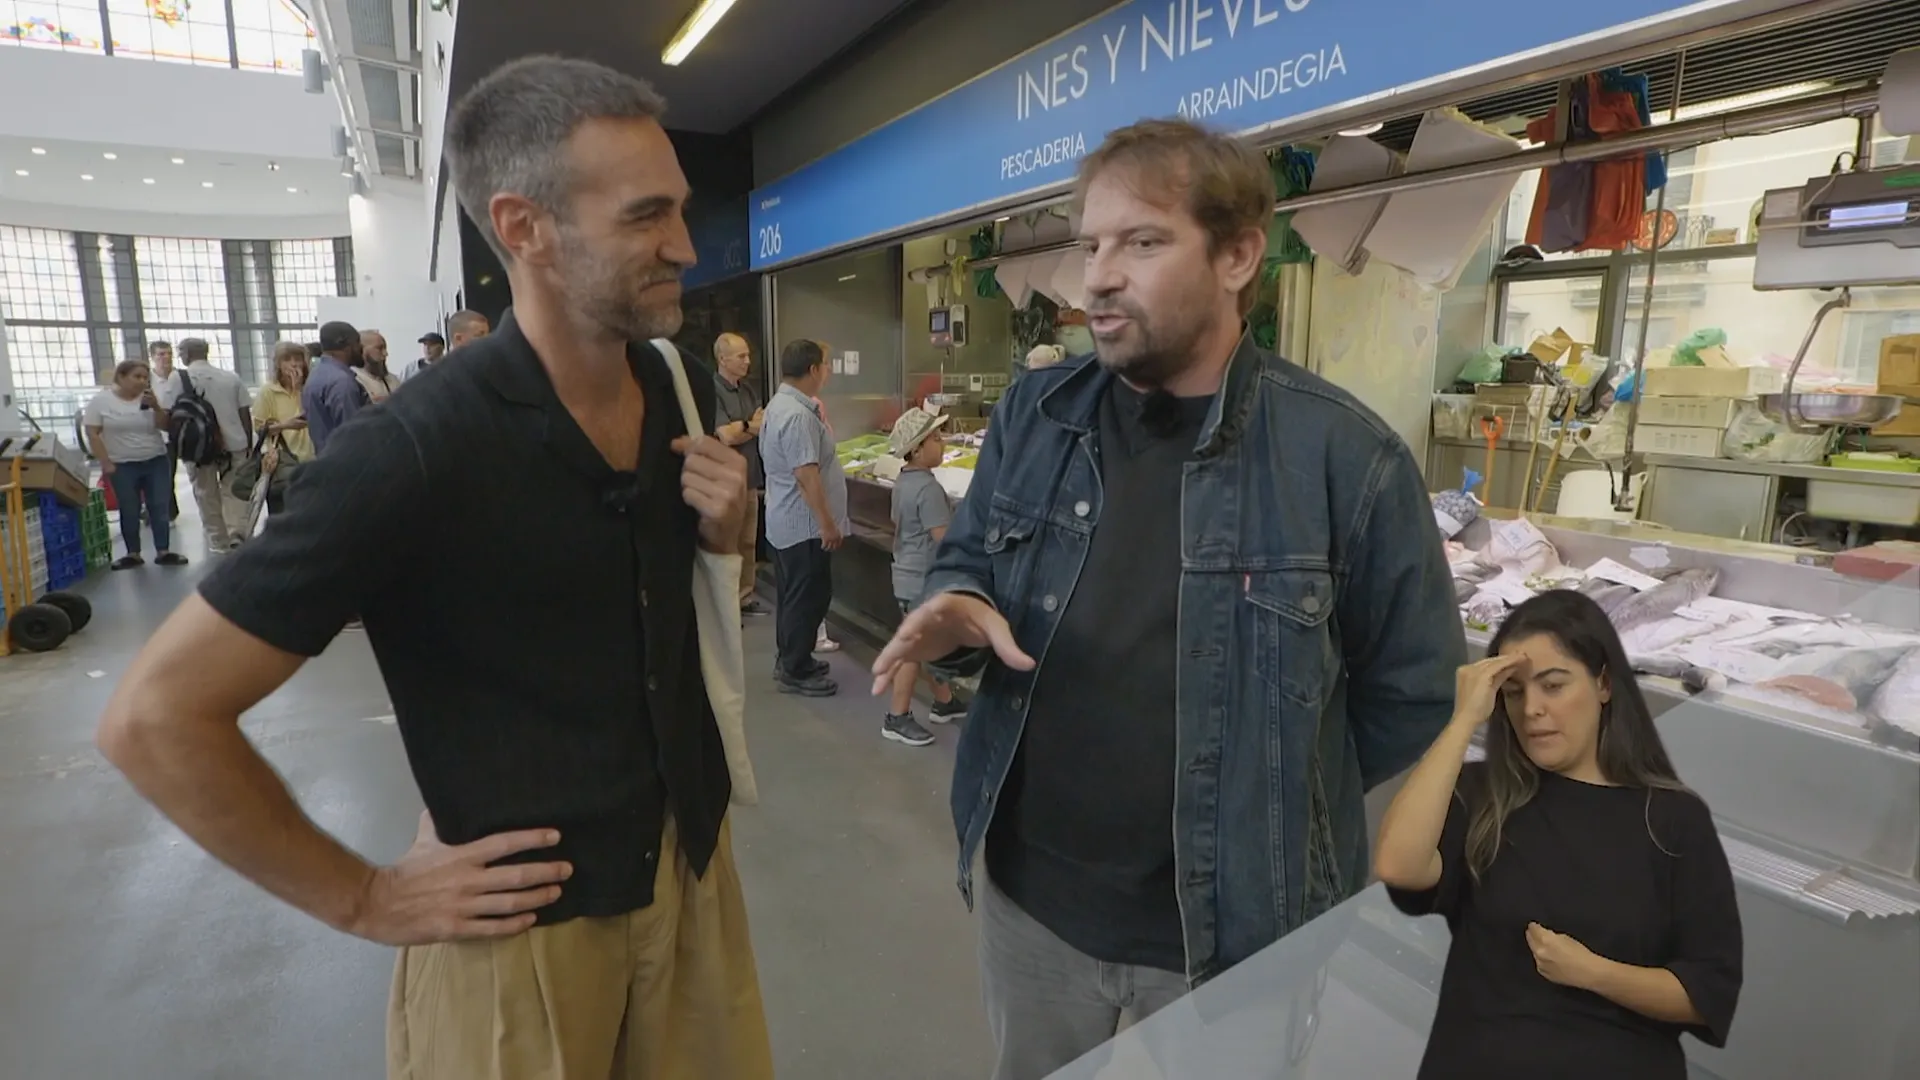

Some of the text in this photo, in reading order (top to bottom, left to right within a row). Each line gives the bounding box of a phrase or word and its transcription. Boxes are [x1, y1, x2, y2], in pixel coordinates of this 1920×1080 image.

[1017, 0, 1310, 121] INES Y NIEV
[1177, 43, 1347, 120] ARRAINDEGIA
[1001, 132, 1085, 180] PESCADERIA
[759, 222, 782, 258] 206
